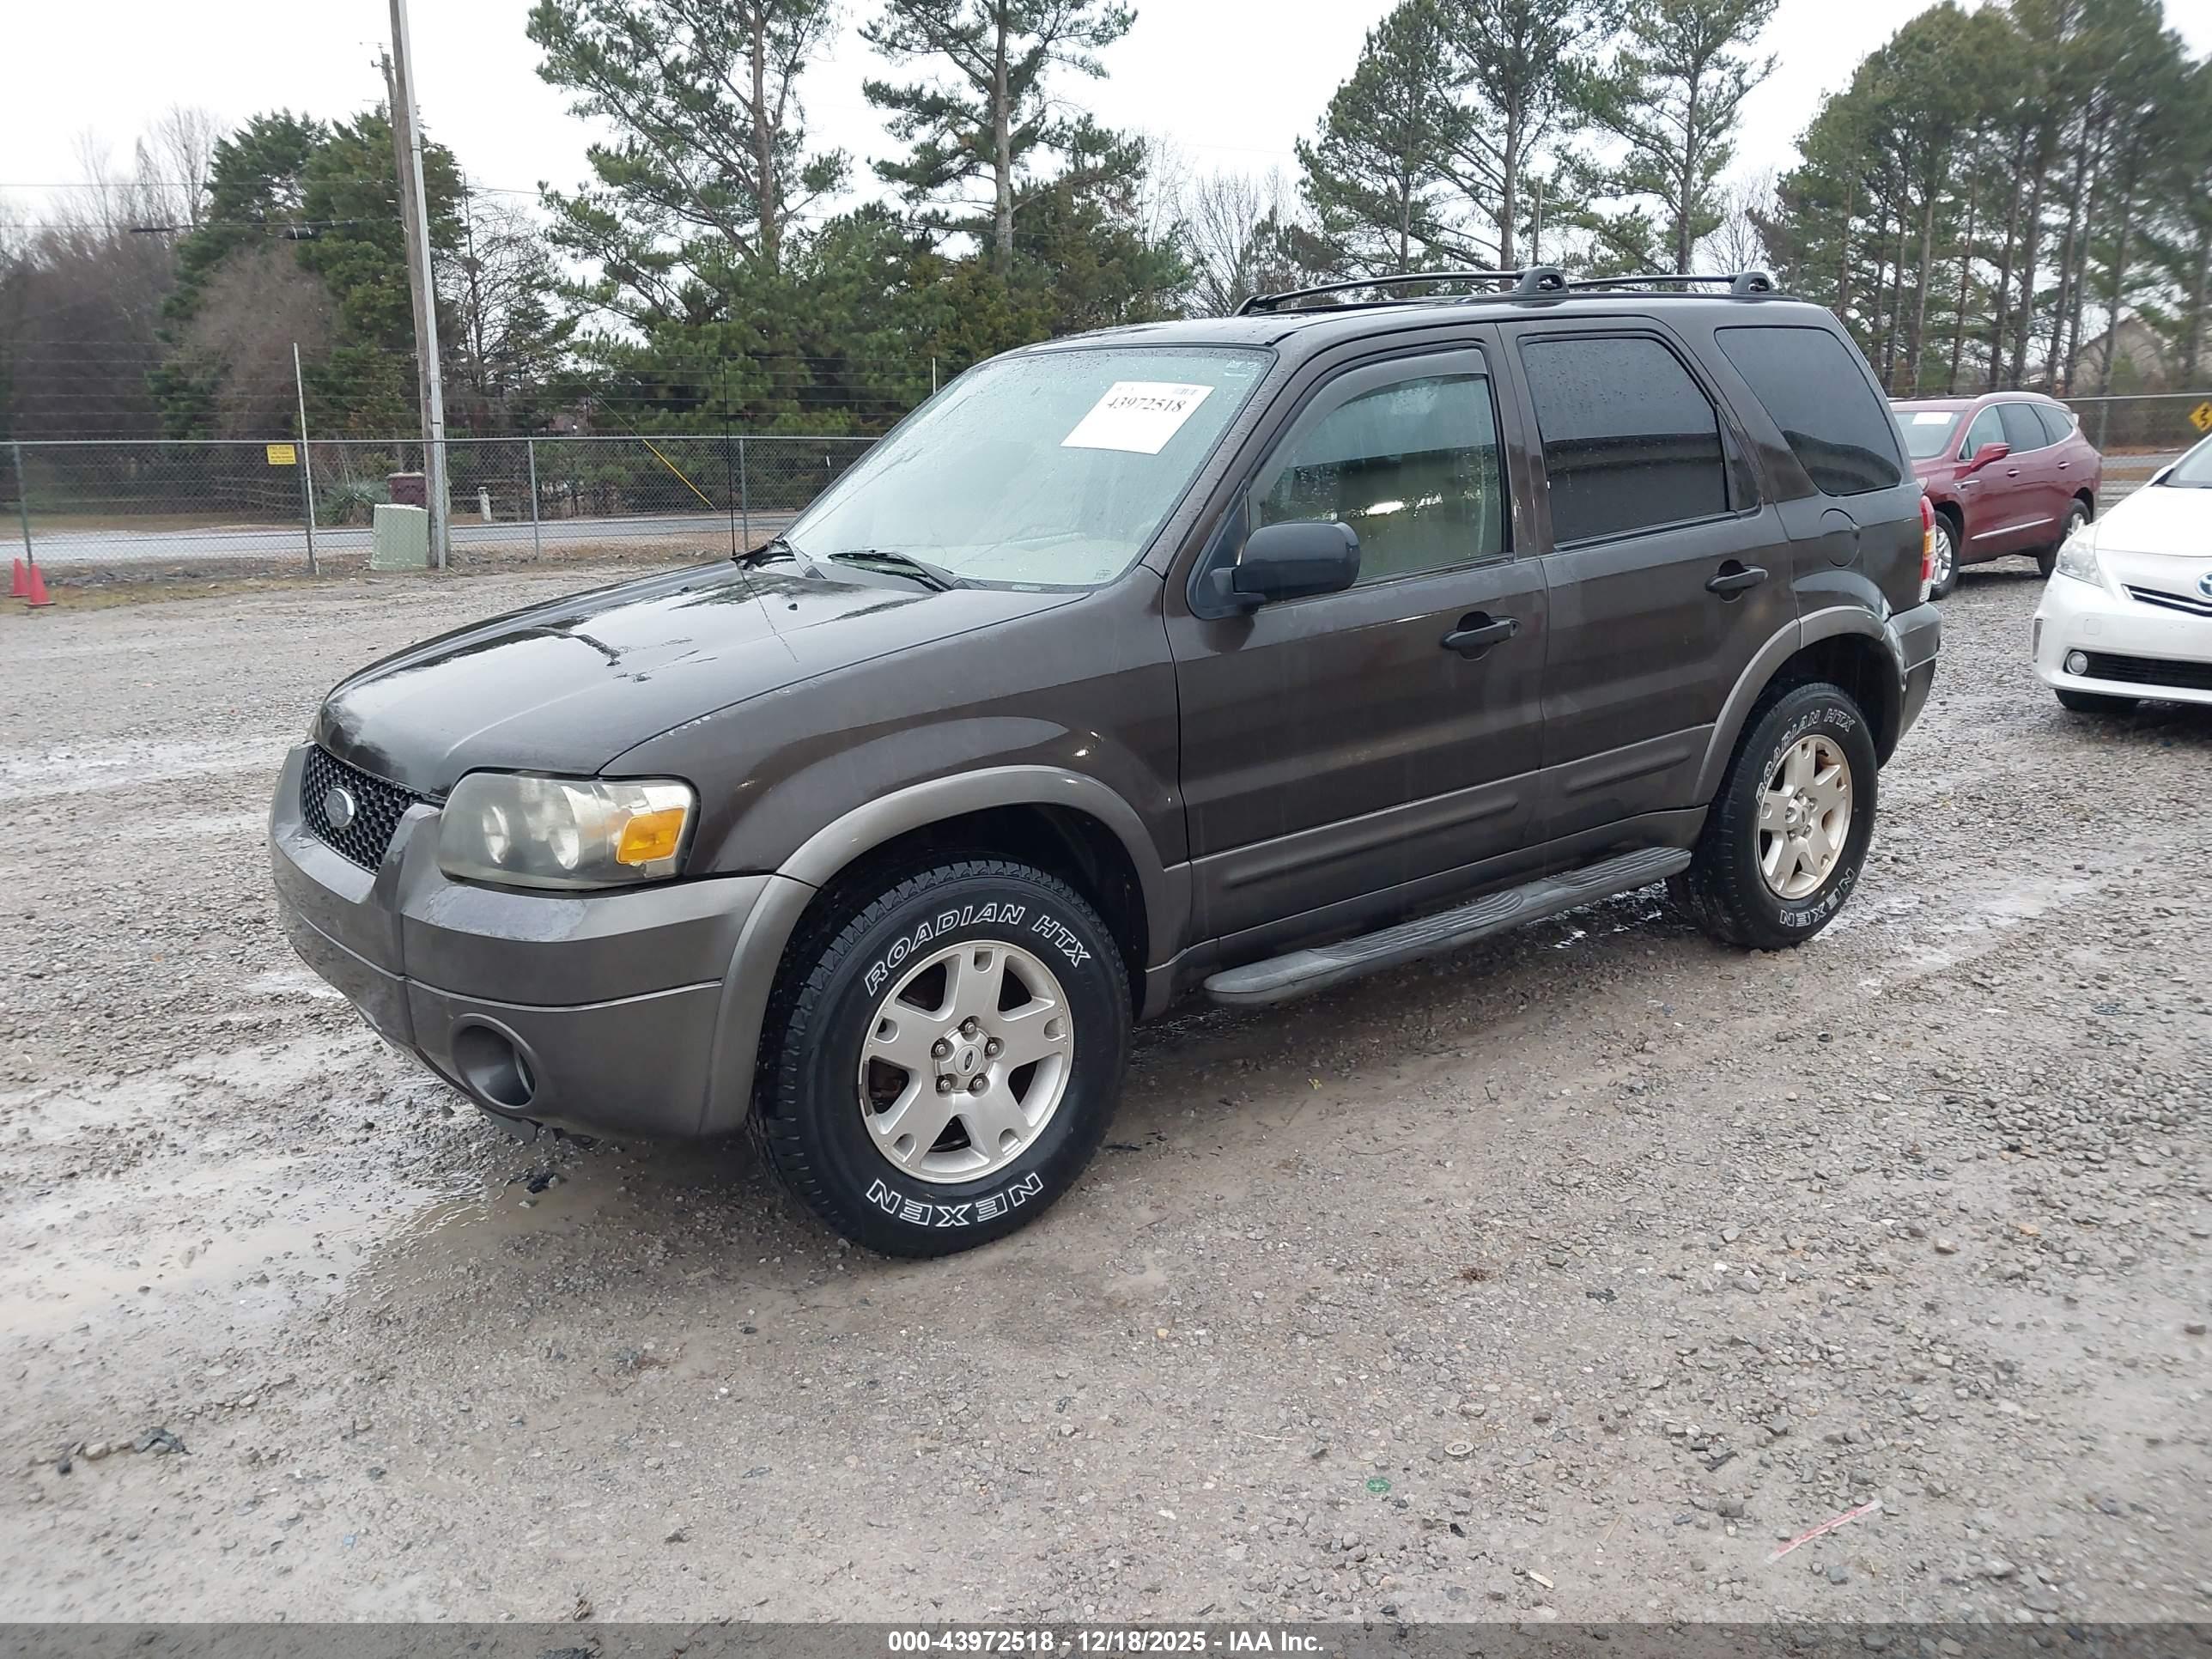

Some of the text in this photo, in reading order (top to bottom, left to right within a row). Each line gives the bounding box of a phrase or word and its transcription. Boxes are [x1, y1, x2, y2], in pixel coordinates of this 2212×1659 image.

[1107, 397, 1187, 412] 43972518
[1823, 708, 1856, 732] HTX
[1779, 867, 1856, 927] NEXEN
[864, 902, 1091, 997] ROADIAN HTX
[866, 1172, 1044, 1227] NEXEN
